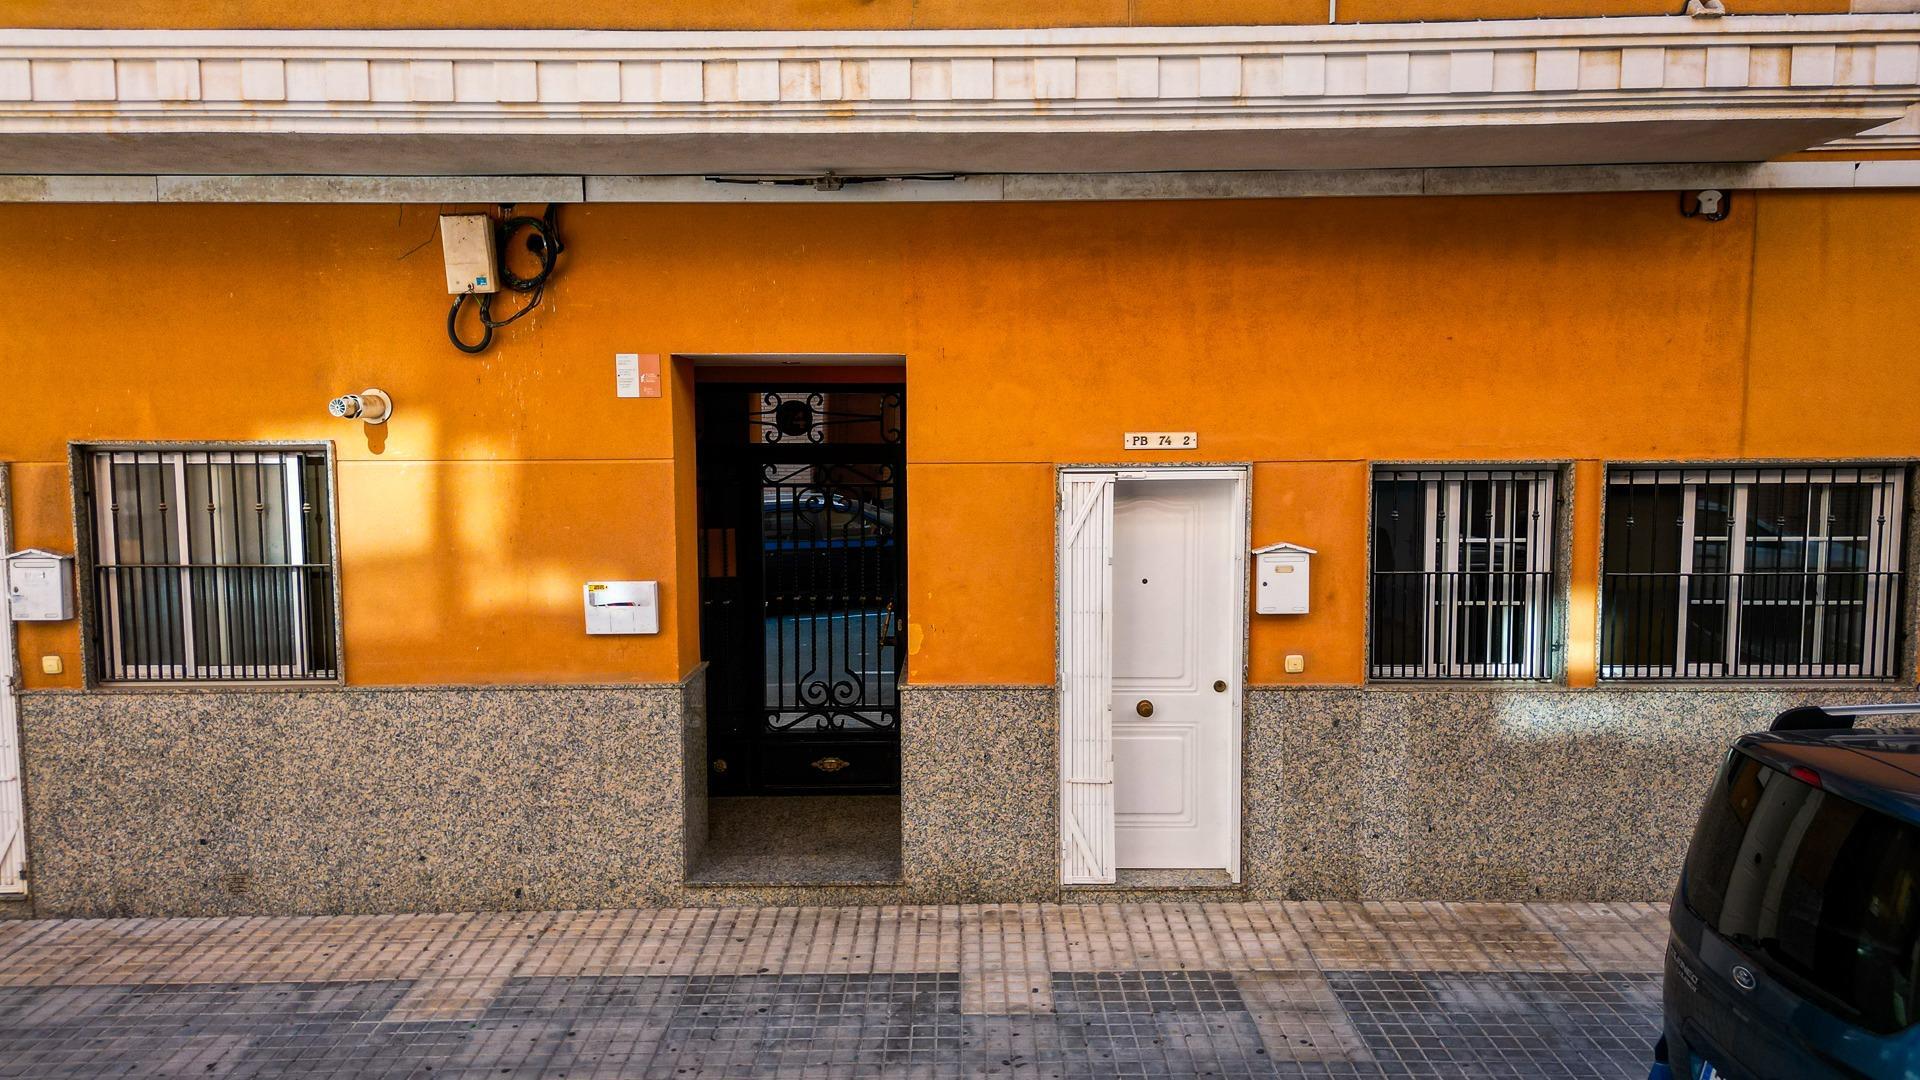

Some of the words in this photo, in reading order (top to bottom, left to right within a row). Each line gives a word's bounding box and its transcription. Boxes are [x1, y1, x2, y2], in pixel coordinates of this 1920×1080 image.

[1132, 436, 1148, 446] PB
[1159, 436, 1172, 446] 74
[1183, 436, 1190, 446] 2
